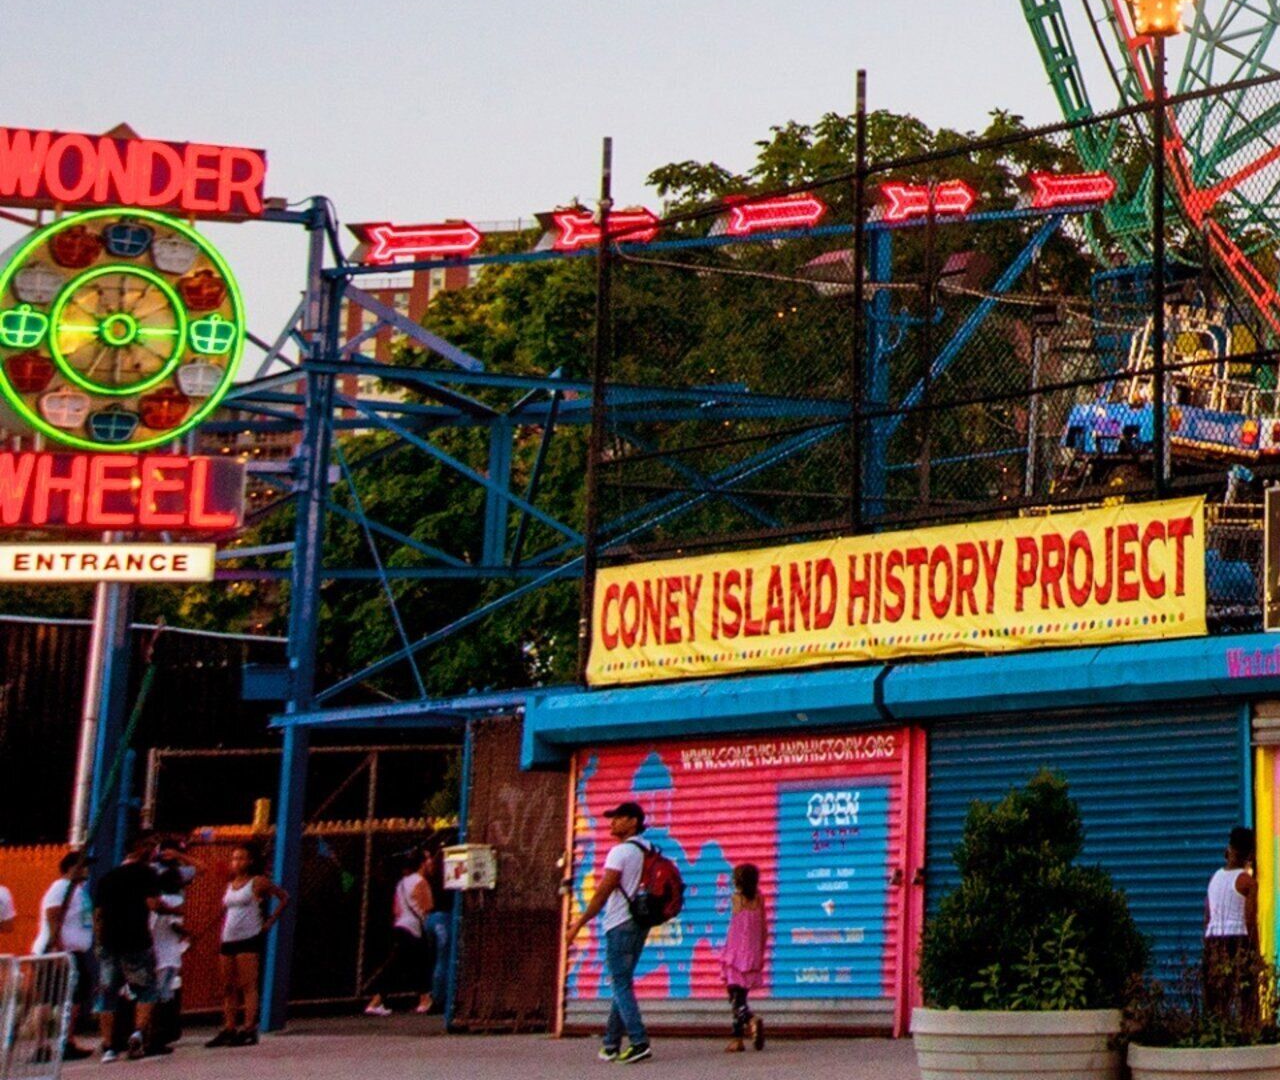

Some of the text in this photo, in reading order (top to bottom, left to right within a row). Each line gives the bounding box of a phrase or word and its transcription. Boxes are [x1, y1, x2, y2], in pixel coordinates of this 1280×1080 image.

[0, 128, 266, 214] WONDER
[0, 453, 237, 528] WHEEL
[14, 553, 189, 571] ENTRANCE
[601, 515, 1195, 652] CONEY ISLAND HISTORY PROJECT
[806, 791, 860, 826] OPEN
